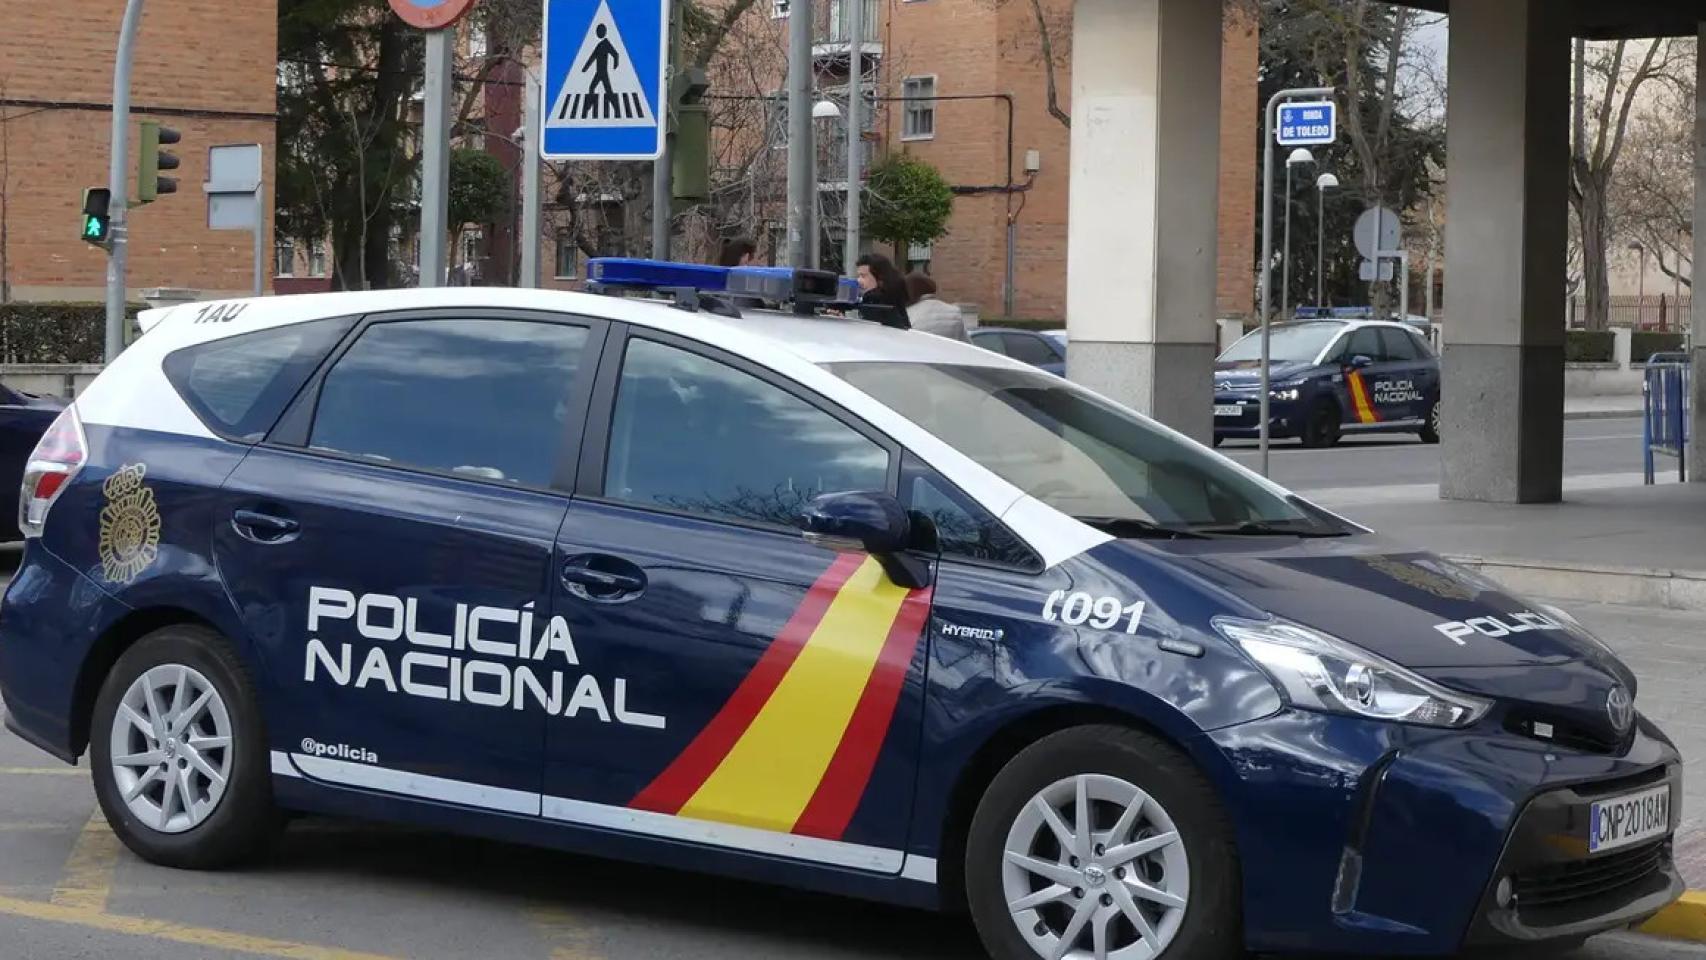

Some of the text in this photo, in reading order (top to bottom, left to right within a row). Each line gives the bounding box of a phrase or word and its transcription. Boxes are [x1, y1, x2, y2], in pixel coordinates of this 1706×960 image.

[1283, 125, 1329, 138] DE TOLEDO
[194, 303, 248, 324] 1AU
[1375, 391, 1424, 403] NACIONAL
[1061, 591, 1146, 635] 091
[307, 586, 580, 665] POLICÍA
[942, 623, 996, 640] HYBRID
[304, 638, 666, 729] NACIONAL
[301, 737, 378, 763] @policia
